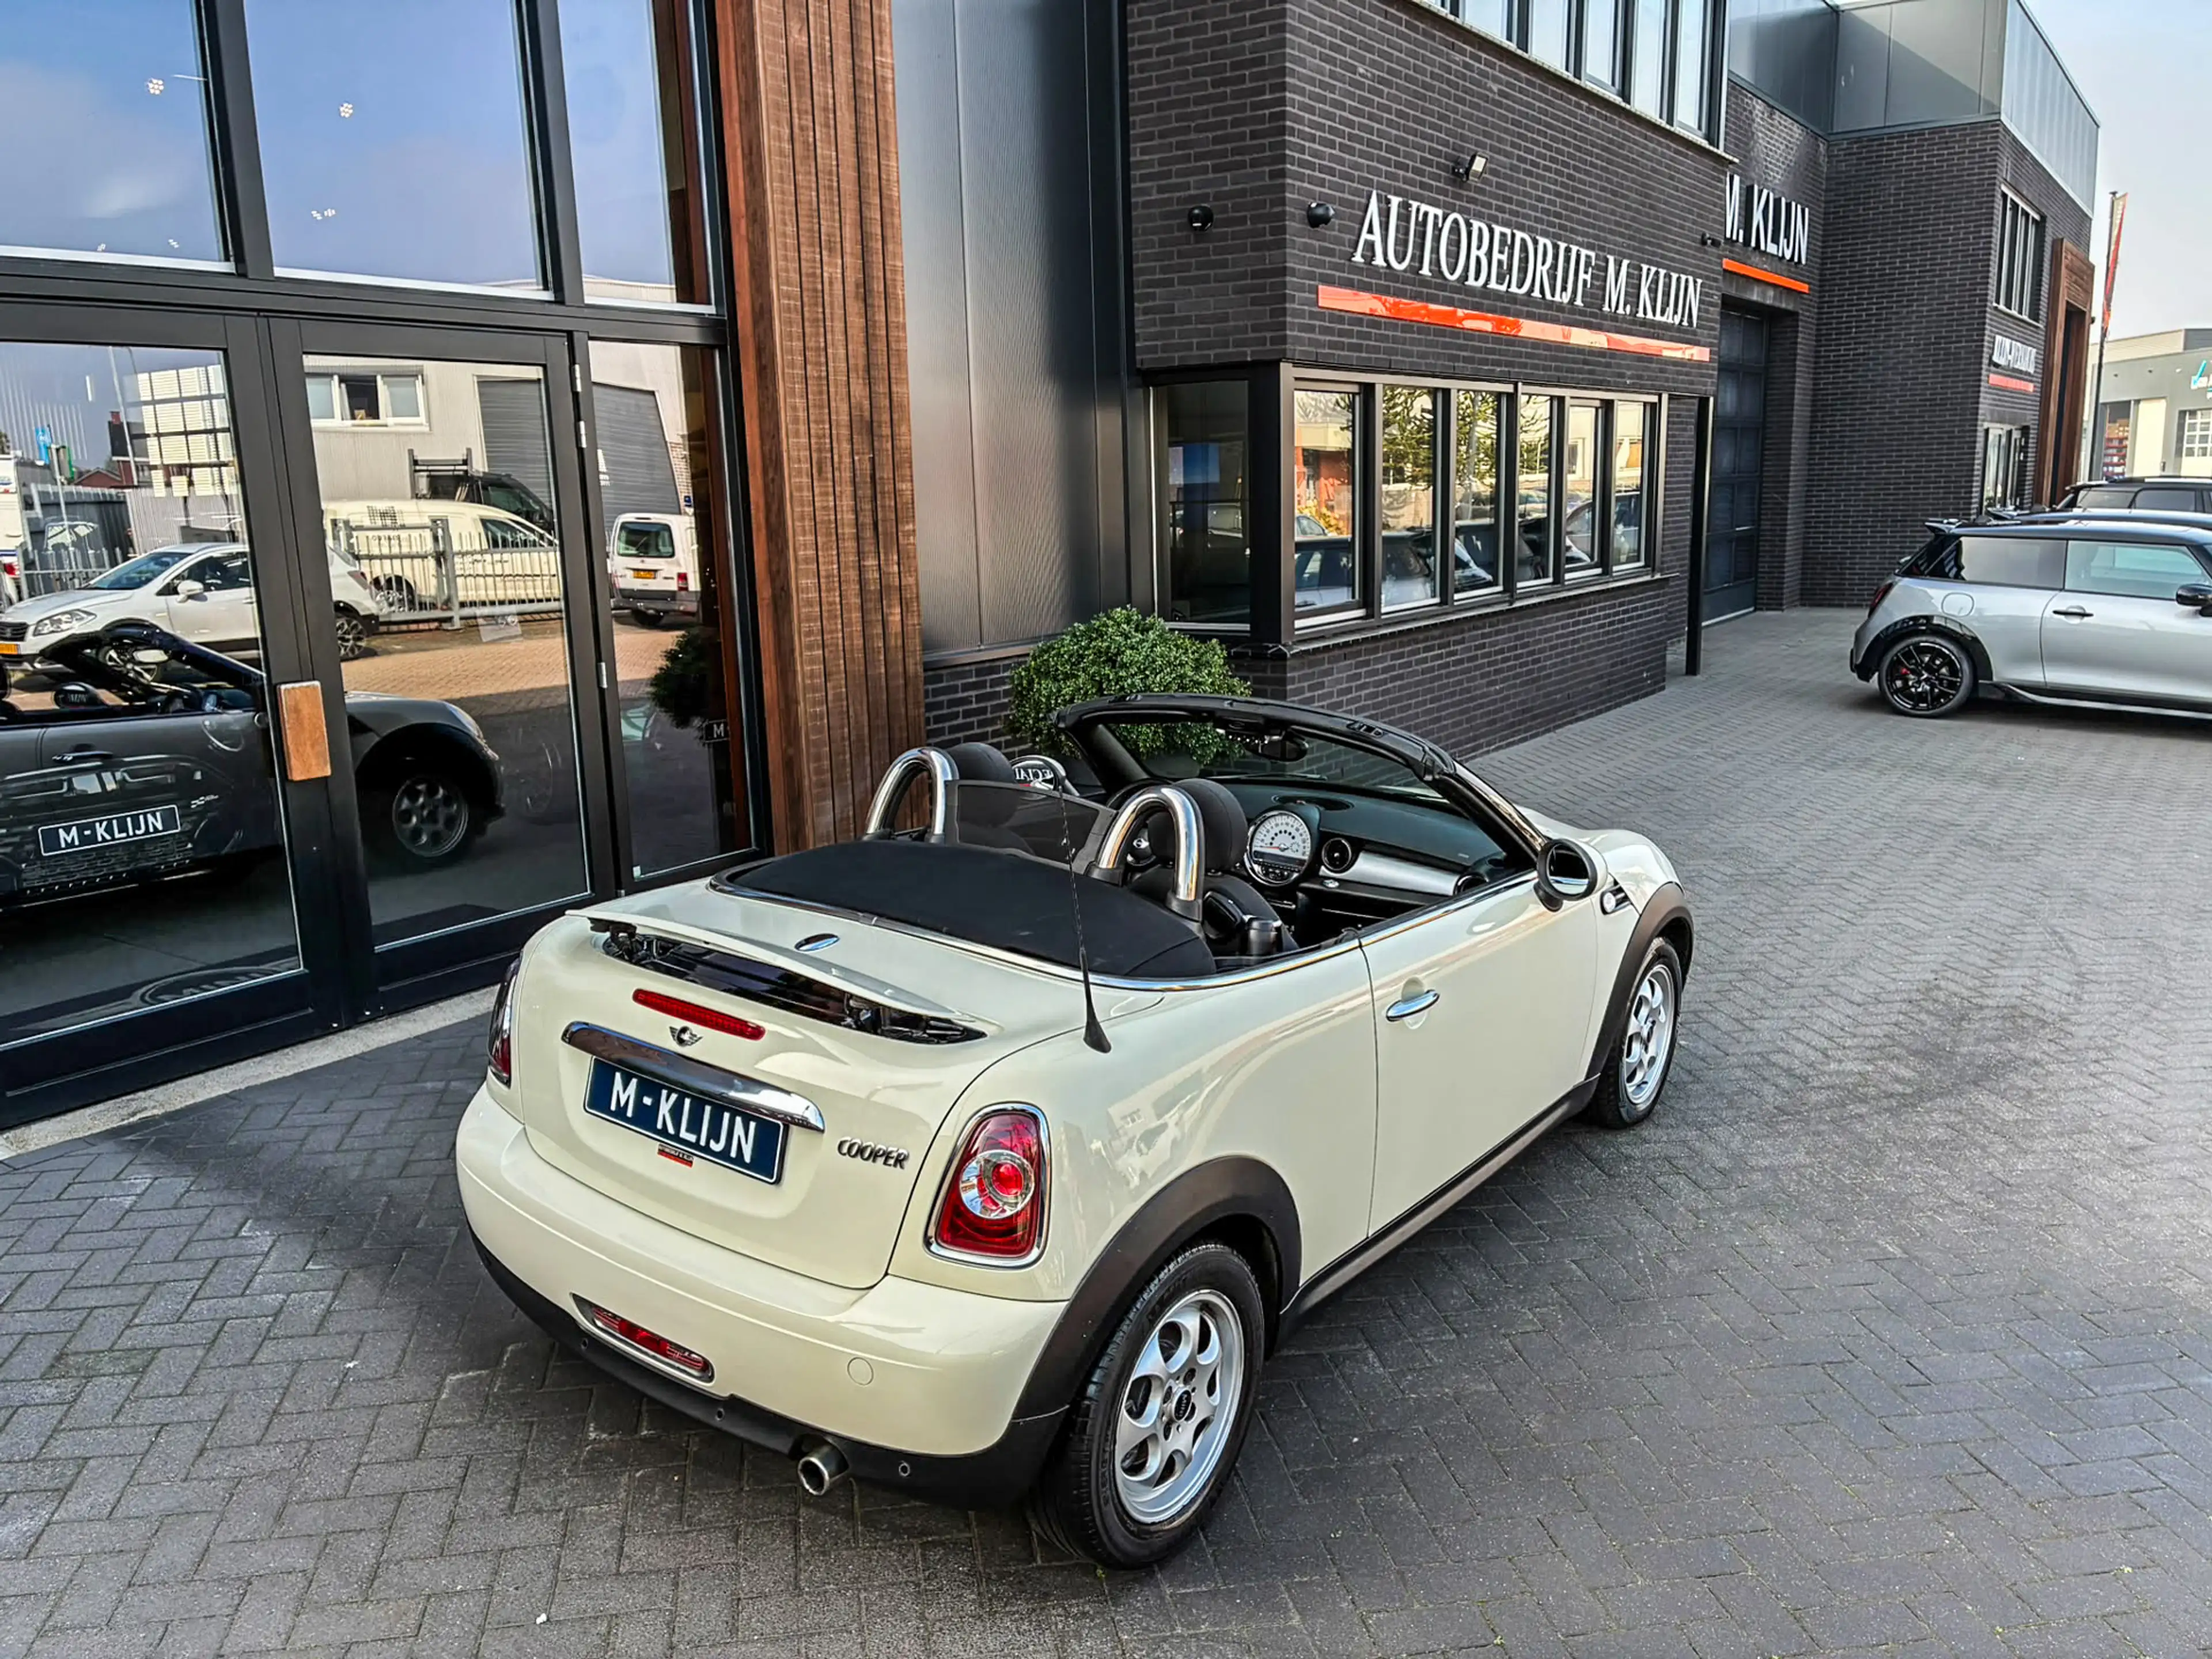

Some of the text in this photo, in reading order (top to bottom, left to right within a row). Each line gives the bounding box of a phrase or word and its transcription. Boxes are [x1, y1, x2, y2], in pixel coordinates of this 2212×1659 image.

[1351, 190, 1703, 328] AUTOBEDRIJF M. KLIJN
[1751, 184, 1809, 265] KLIJN
[58, 811, 163, 849] M-KLIJN
[610, 1071, 757, 1164] M-KLIJN
[837, 1137, 910, 1170] COOPER
